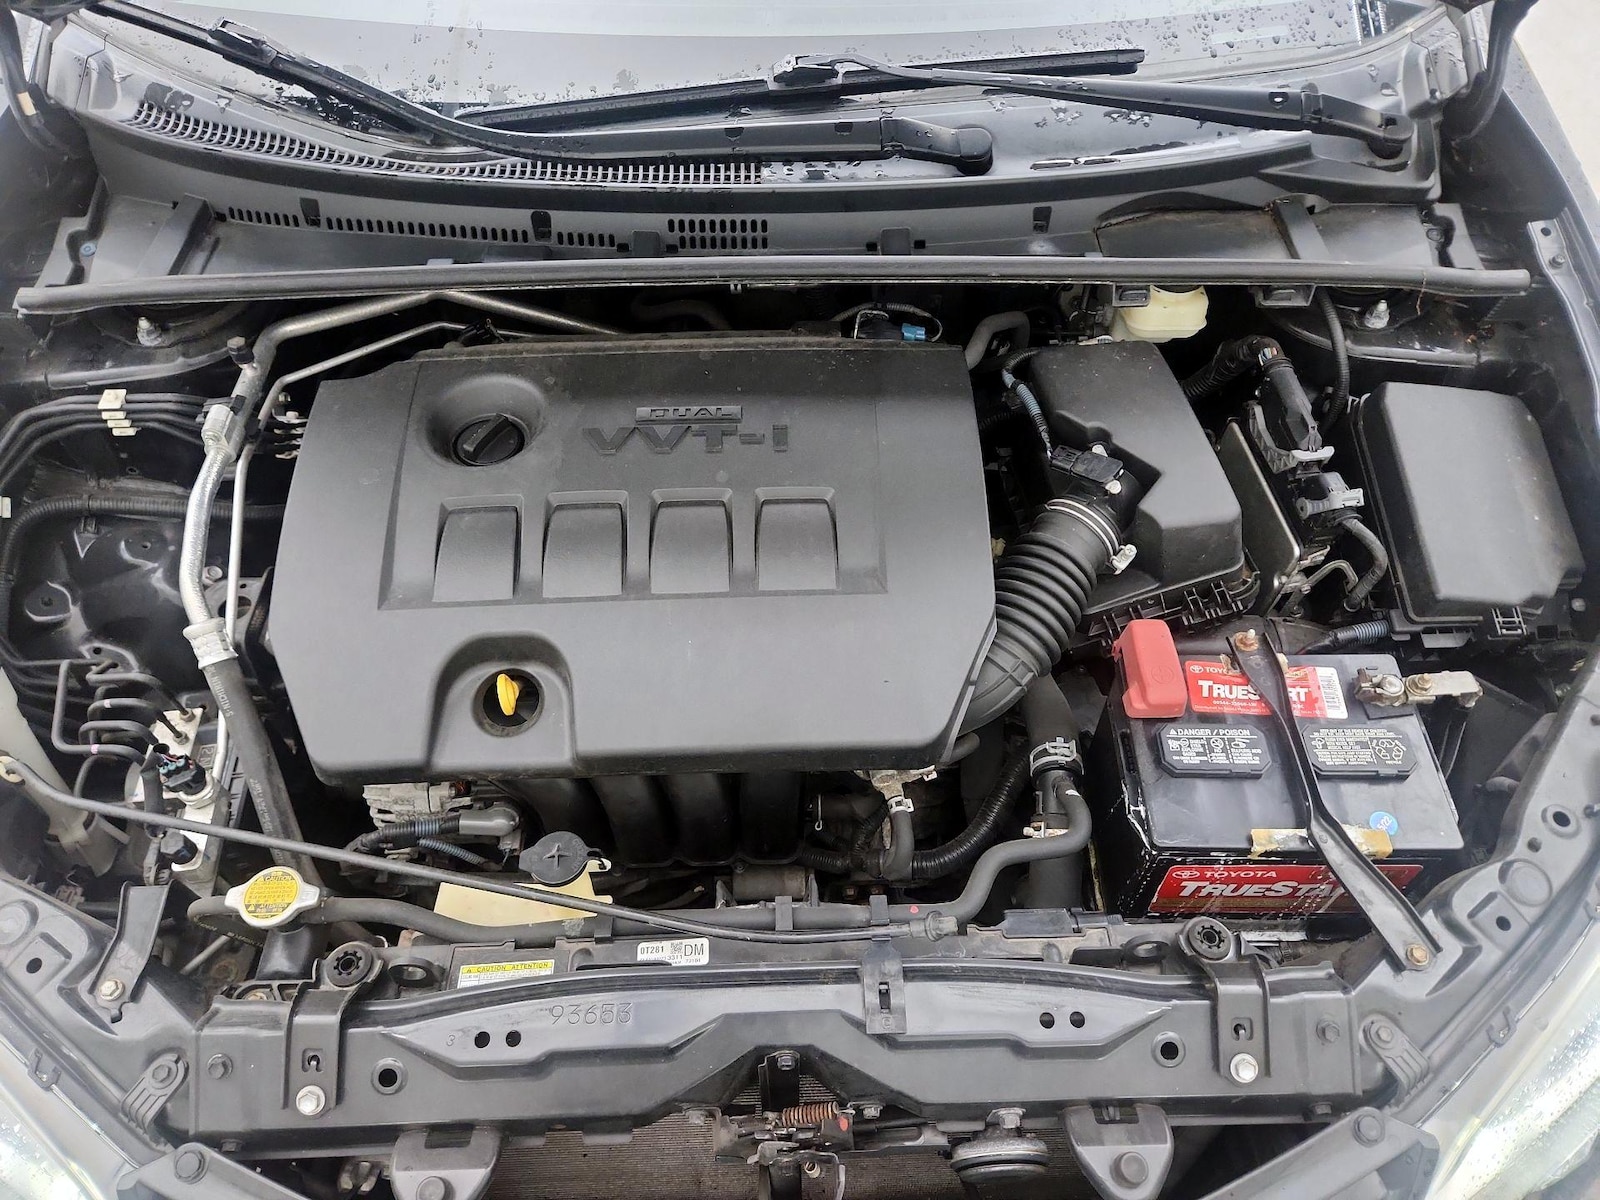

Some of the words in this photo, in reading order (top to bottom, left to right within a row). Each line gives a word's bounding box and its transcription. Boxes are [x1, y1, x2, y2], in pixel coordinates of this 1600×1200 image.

[650, 407, 733, 418] DUAL
[1197, 680, 1309, 702] TRUESRT
[1177, 728, 1212, 736] DANGER
[1203, 870, 1277, 879] TOYOTA
[684, 943, 704, 957] DM
[476, 965, 507, 973] CAUTION
[511, 962, 549, 970] ATTENTION
[551, 1002, 632, 1025] 93653
